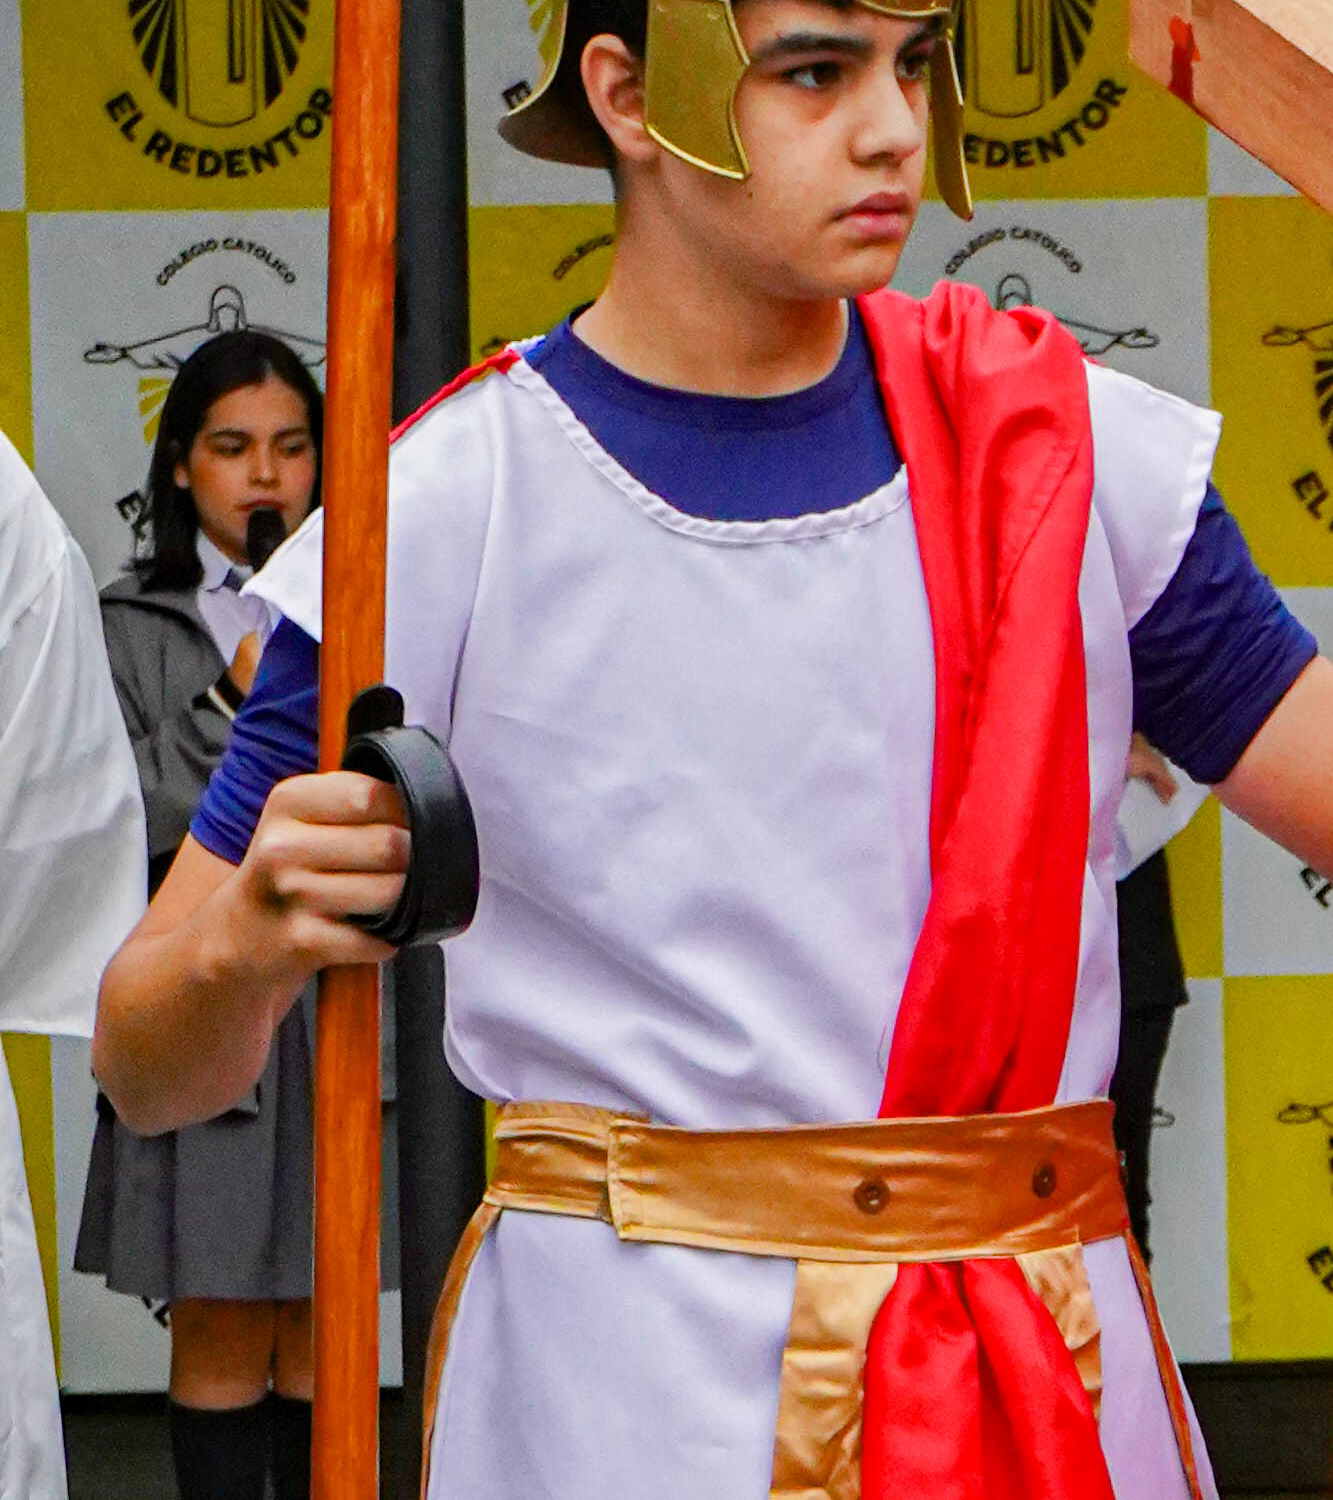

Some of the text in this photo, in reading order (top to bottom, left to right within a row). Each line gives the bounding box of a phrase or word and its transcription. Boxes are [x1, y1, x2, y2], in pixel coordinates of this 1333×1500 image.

[105, 88, 333, 179] EL REDENTOR
[964, 78, 1128, 169] EDENTOR
[1292, 470, 1329, 520] EL
